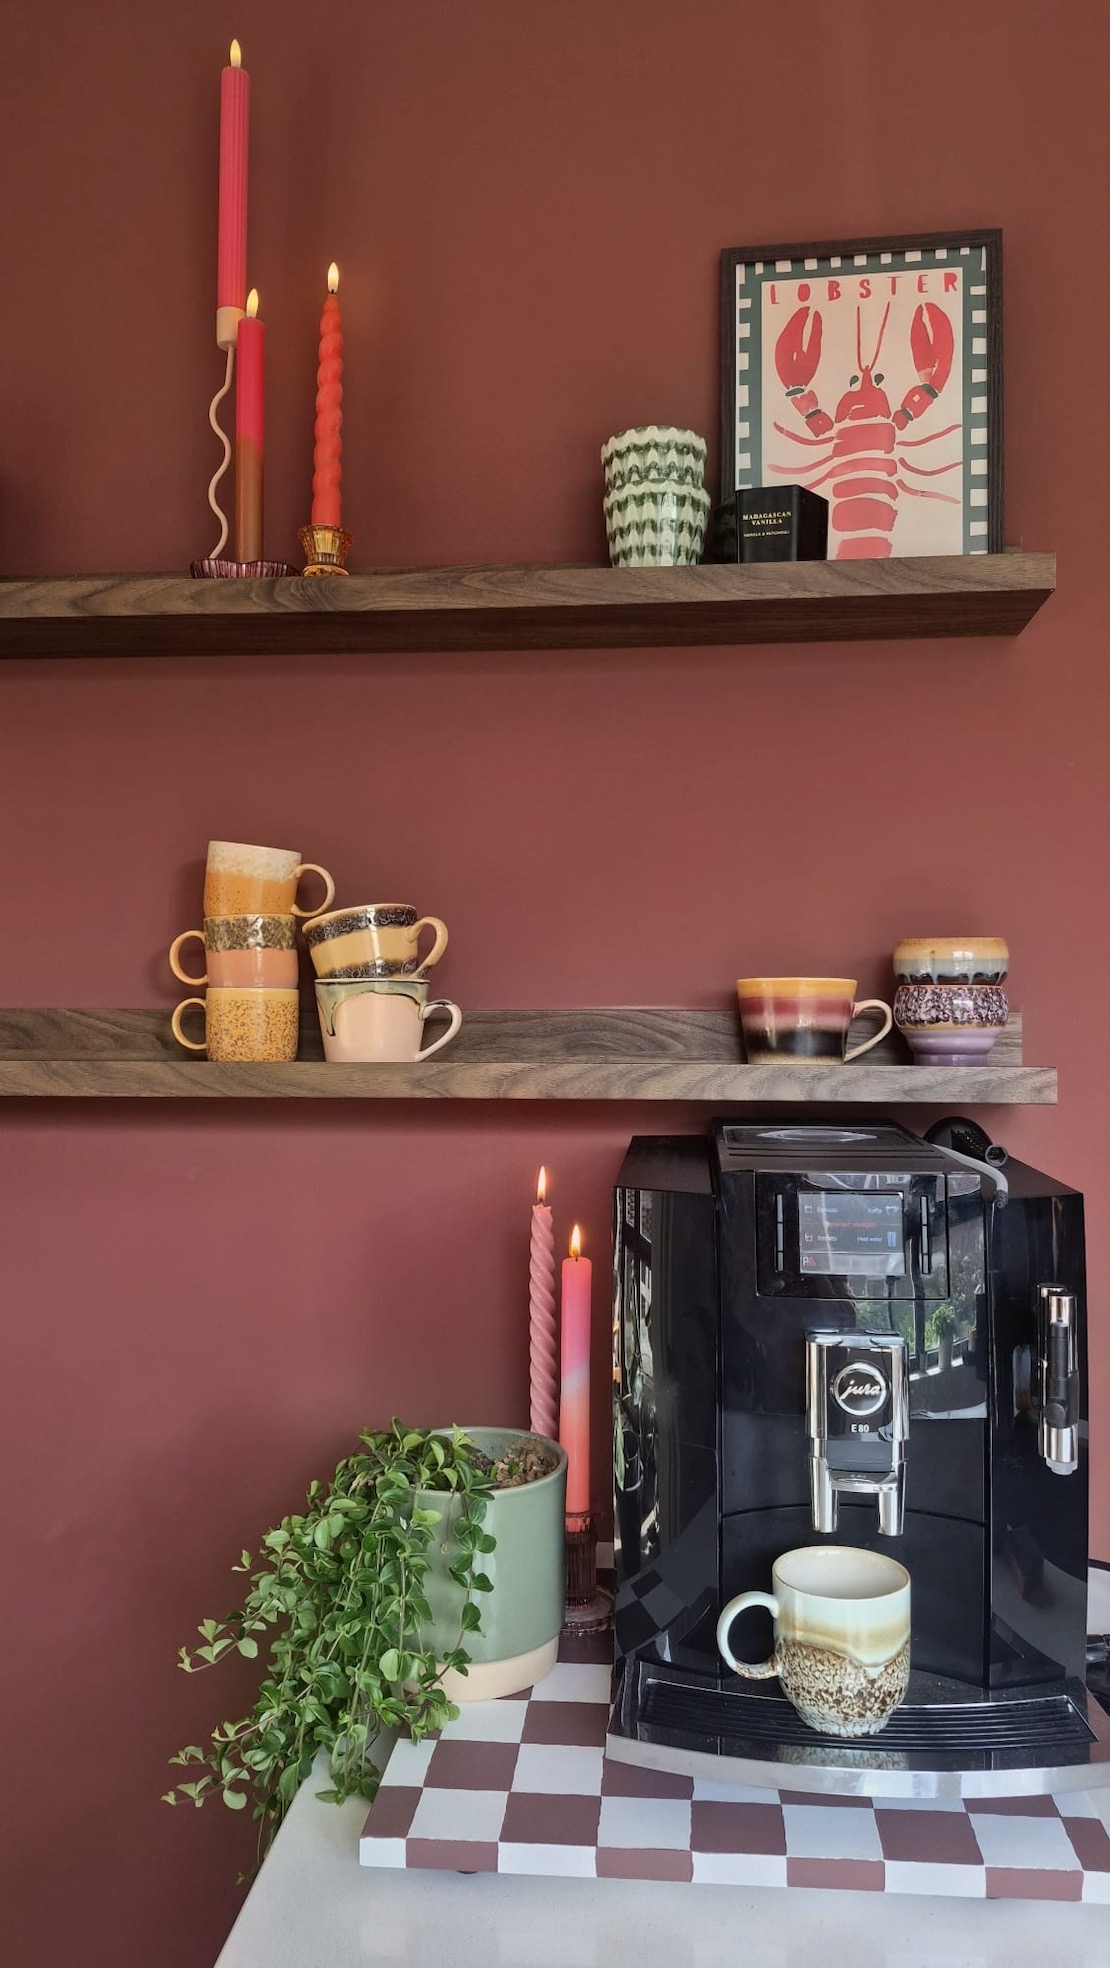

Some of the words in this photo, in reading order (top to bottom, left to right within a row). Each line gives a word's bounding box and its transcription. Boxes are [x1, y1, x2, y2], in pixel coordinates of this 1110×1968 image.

[770, 272, 958, 305] LOBSTER
[742, 511, 792, 521] MADAGASCAN
[751, 518, 783, 526] VANILLA
[840, 1380, 881, 1400] jura
[851, 1423, 858, 1433] E
[858, 1423, 870, 1433] 80
